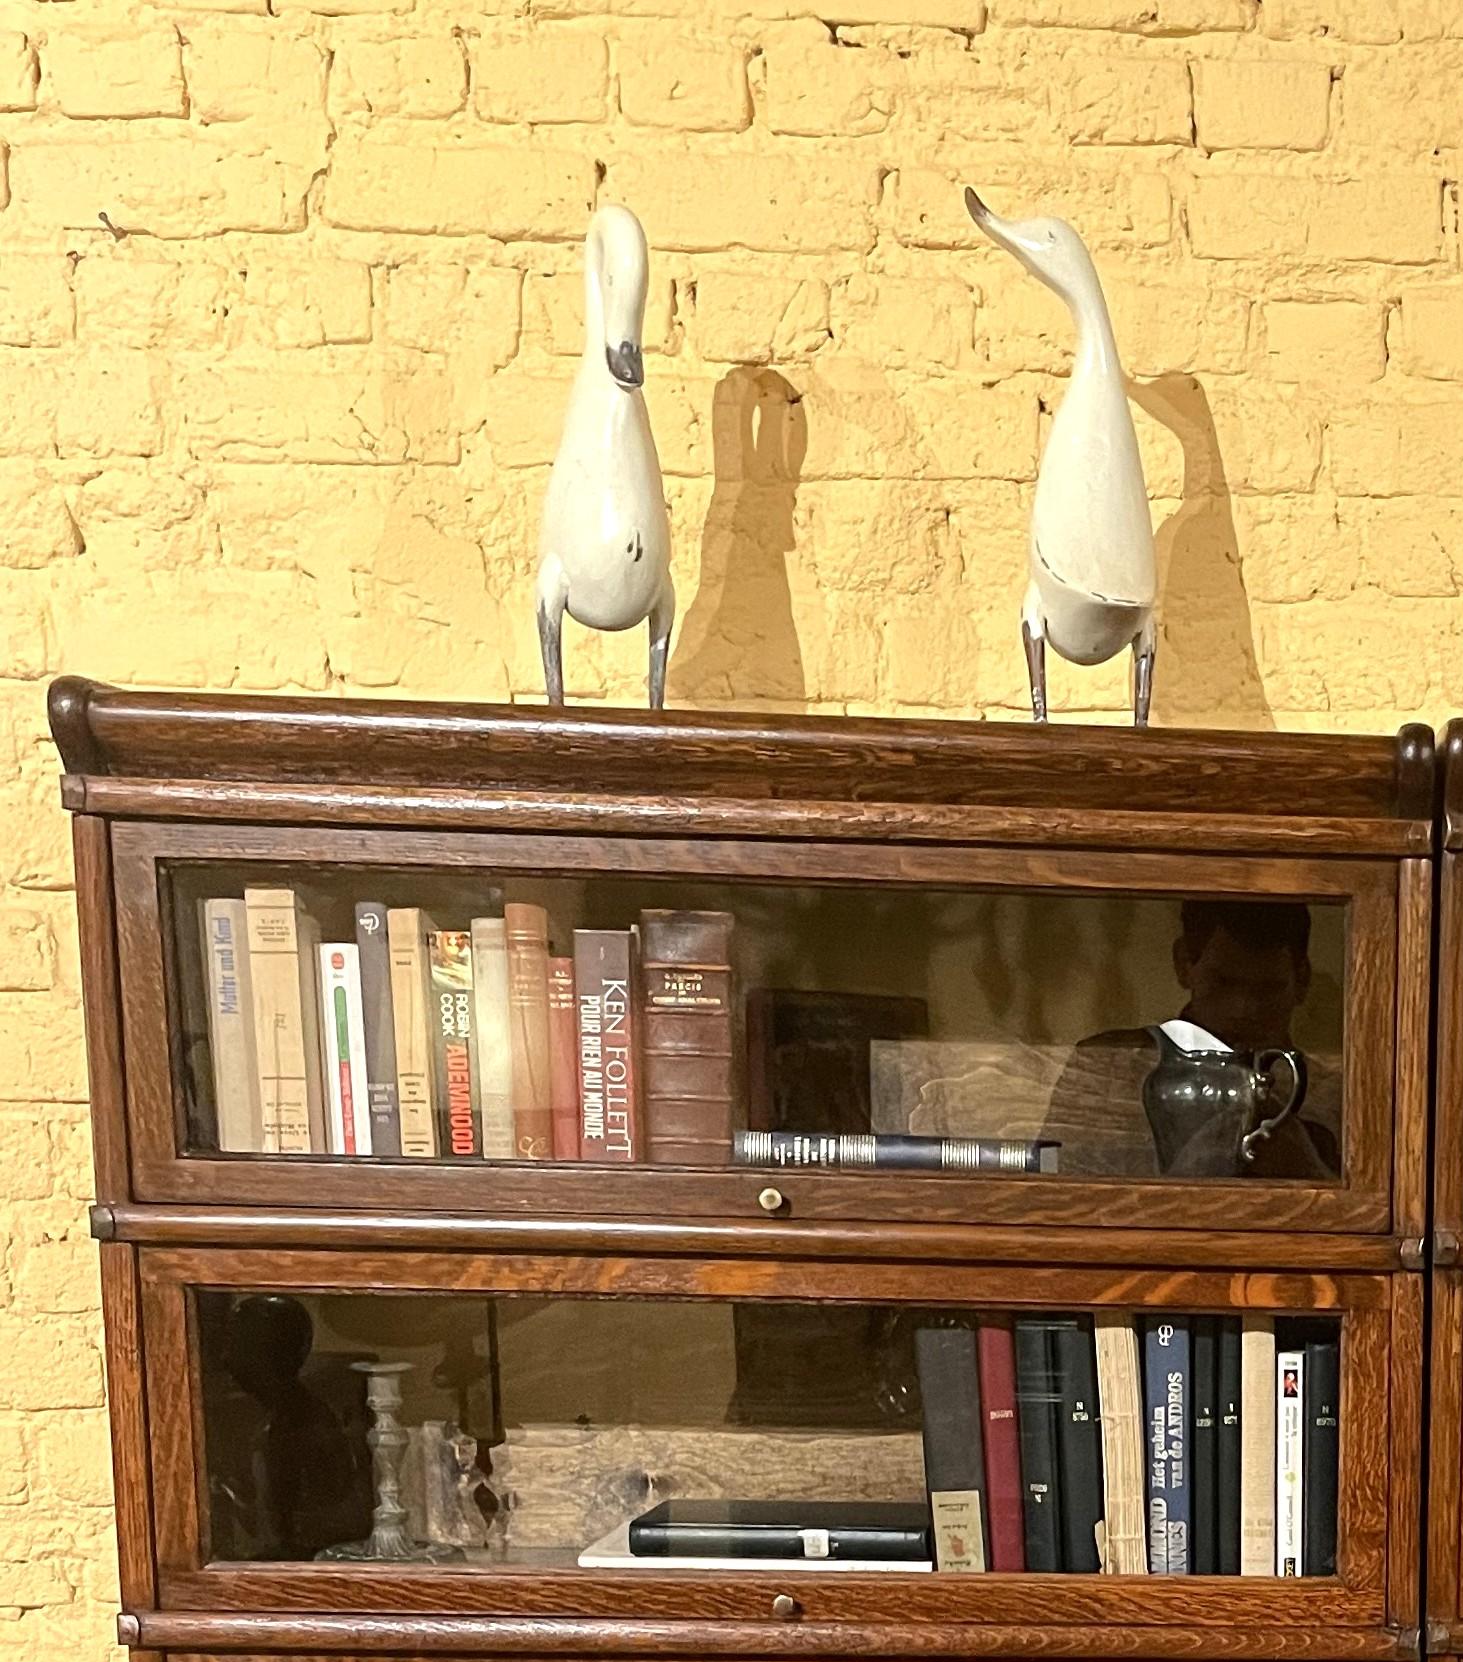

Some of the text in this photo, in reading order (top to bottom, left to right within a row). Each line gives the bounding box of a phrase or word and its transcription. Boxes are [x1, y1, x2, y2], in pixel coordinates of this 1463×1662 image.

[440, 993, 456, 1037] COOK
[456, 993, 469, 1038] ROBIN
[580, 995, 604, 1139] POUR RIEN AU MONDE
[601, 979, 631, 1159] KEN FOLLETT
[447, 1043, 474, 1154] ADEMNOOD
[1151, 1406, 1168, 1488] Het geheim
[1167, 1371, 1184, 1488] van de ANDROS
